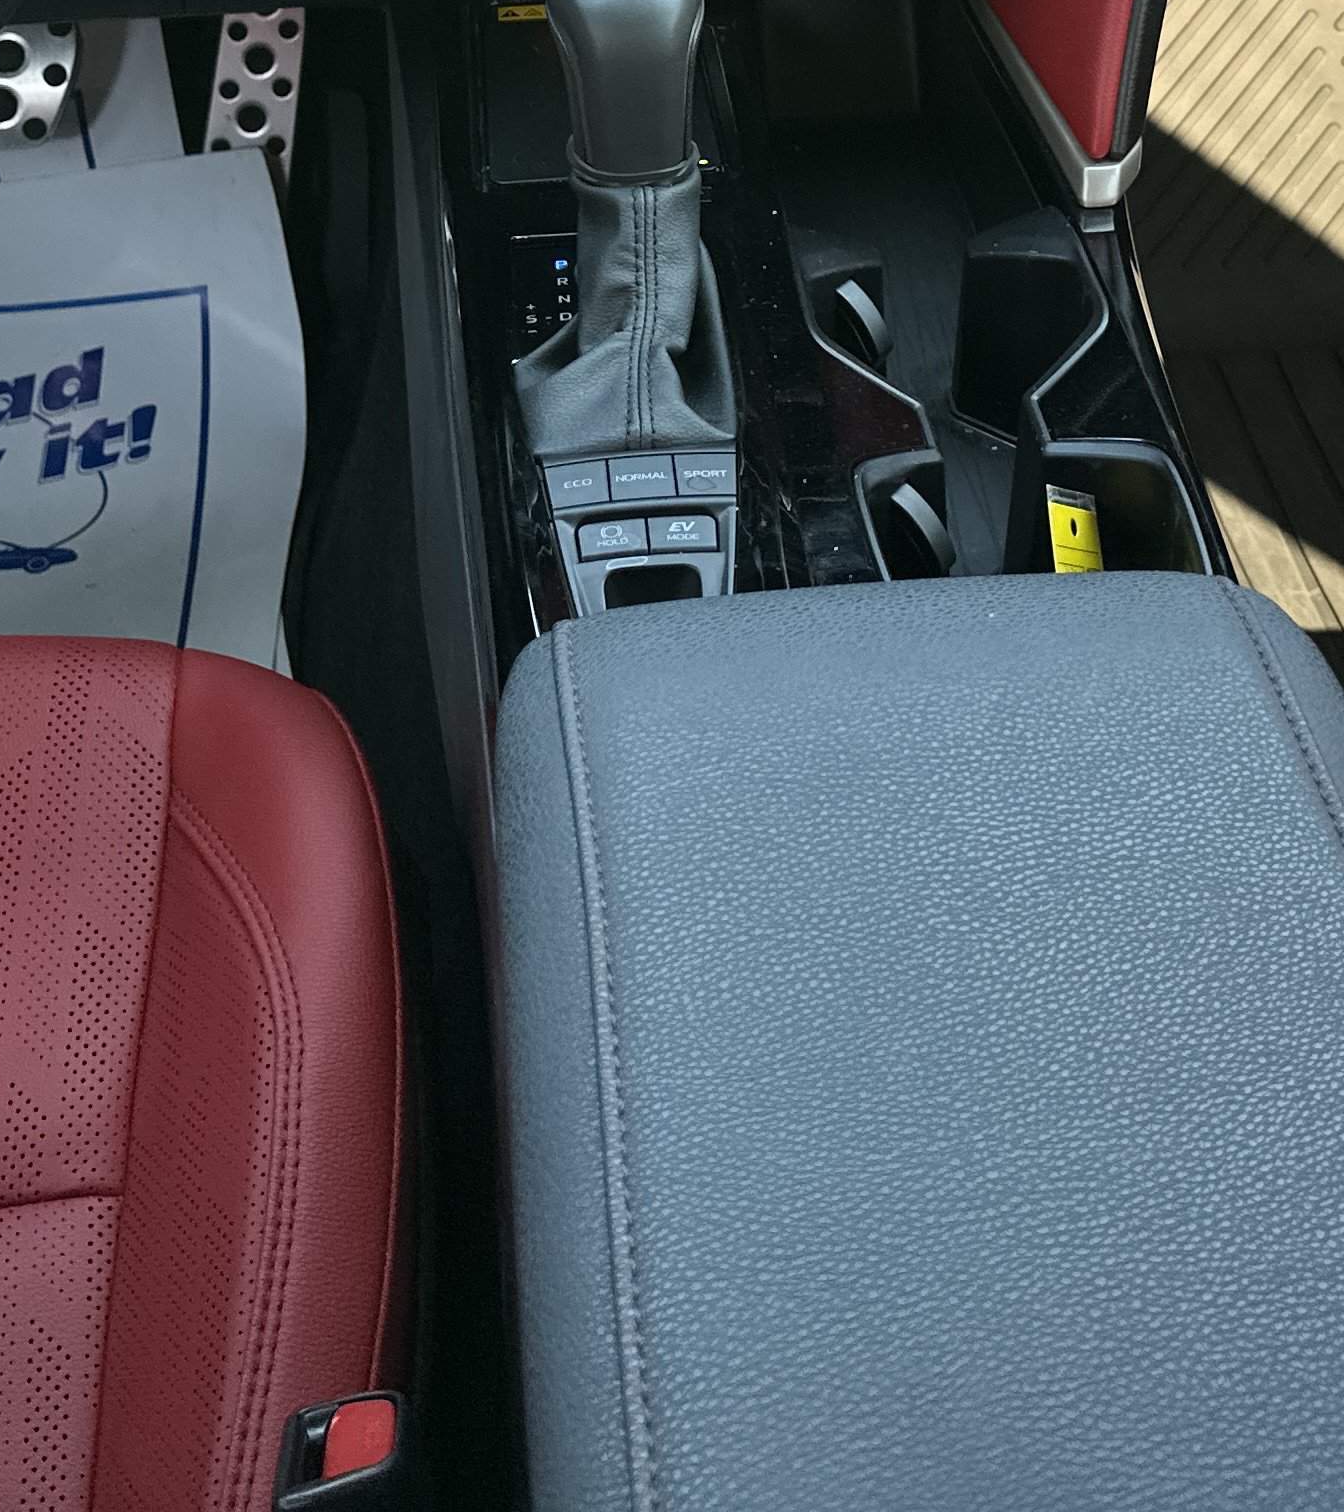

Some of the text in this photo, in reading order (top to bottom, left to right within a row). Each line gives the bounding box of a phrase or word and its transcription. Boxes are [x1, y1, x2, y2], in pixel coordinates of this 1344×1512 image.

[555, 259, 568, 270] P
[557, 277, 569, 286] R
[558, 294, 571, 304] N
[526, 314, 538, 324] S
[559, 312, 572, 322] D
[38, 403, 159, 484] it!
[615, 471, 668, 483] NORMAL
[683, 469, 728, 478] SPORT
[563, 478, 593, 489] ECO
[668, 521, 697, 532] EV
[596, 536, 629, 548] HOLD
[666, 533, 699, 541] MODE
